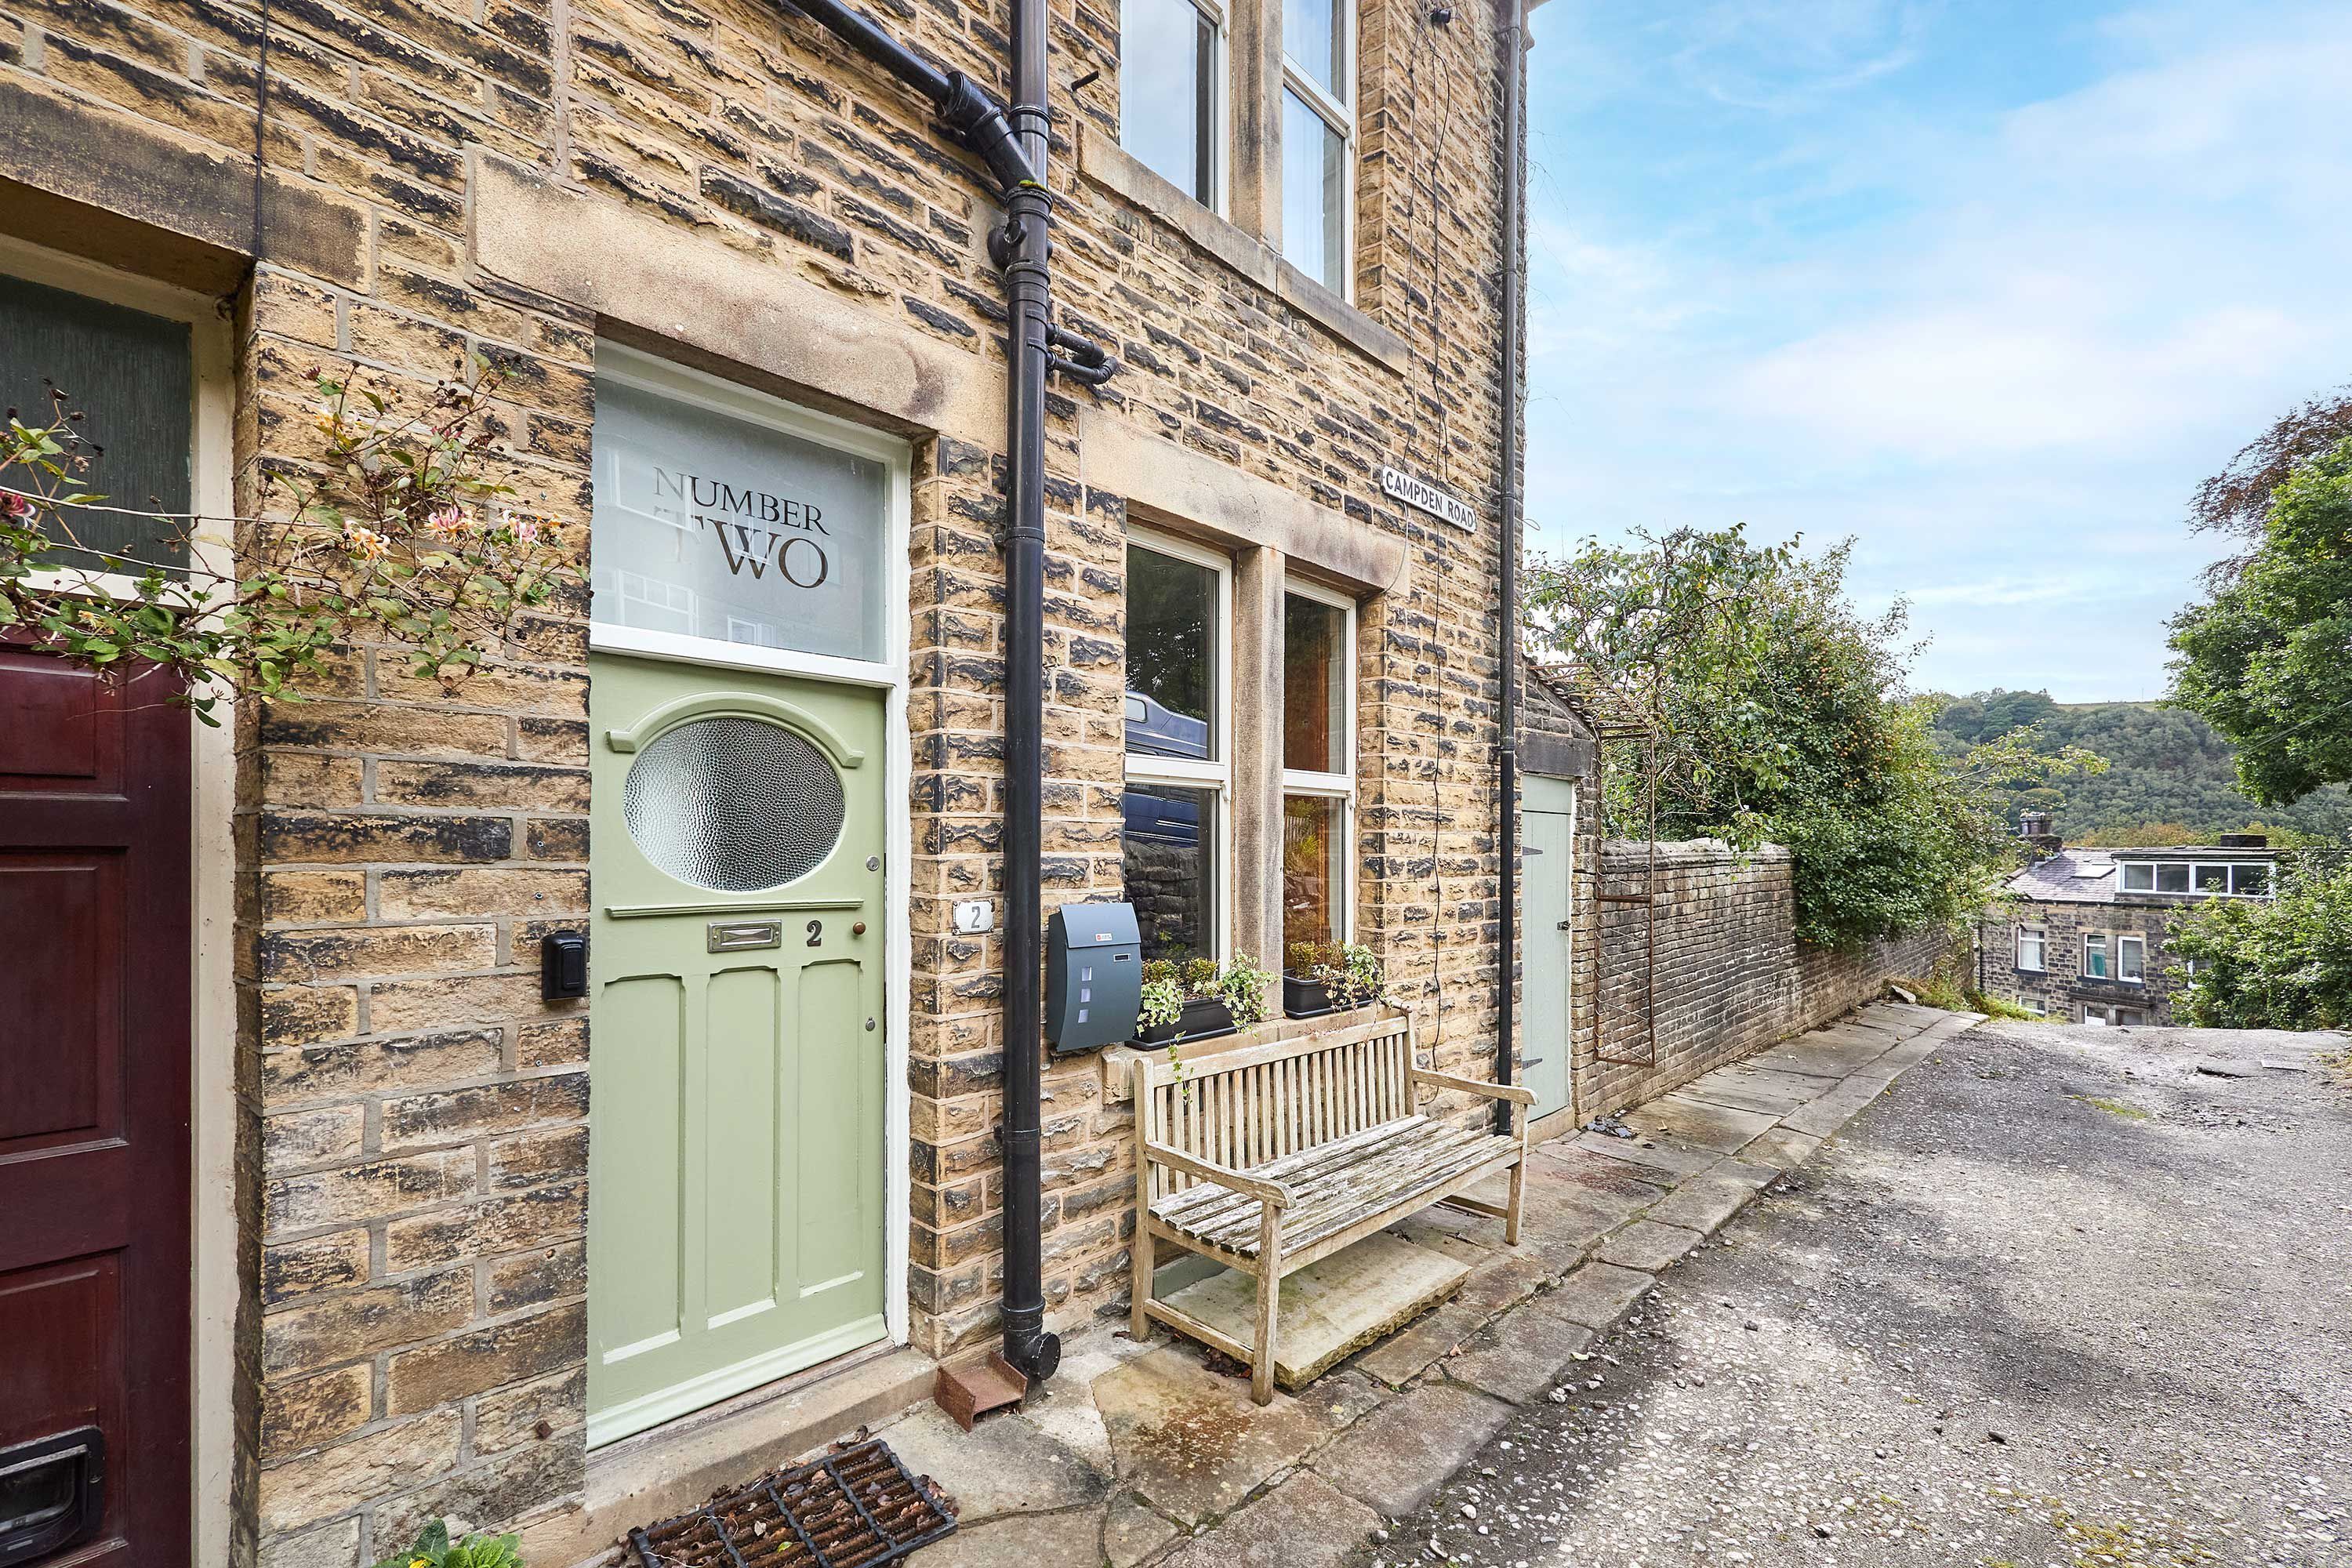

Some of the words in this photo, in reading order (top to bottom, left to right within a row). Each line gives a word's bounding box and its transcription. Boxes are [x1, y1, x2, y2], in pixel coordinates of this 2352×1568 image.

[653, 466, 831, 535] NUMBER
[1386, 471, 1443, 513] CAMPDEN
[1447, 500, 1474, 528] ROAD
[654, 506, 829, 589] TWO
[806, 920, 822, 947] 2
[971, 906, 981, 929] 2
